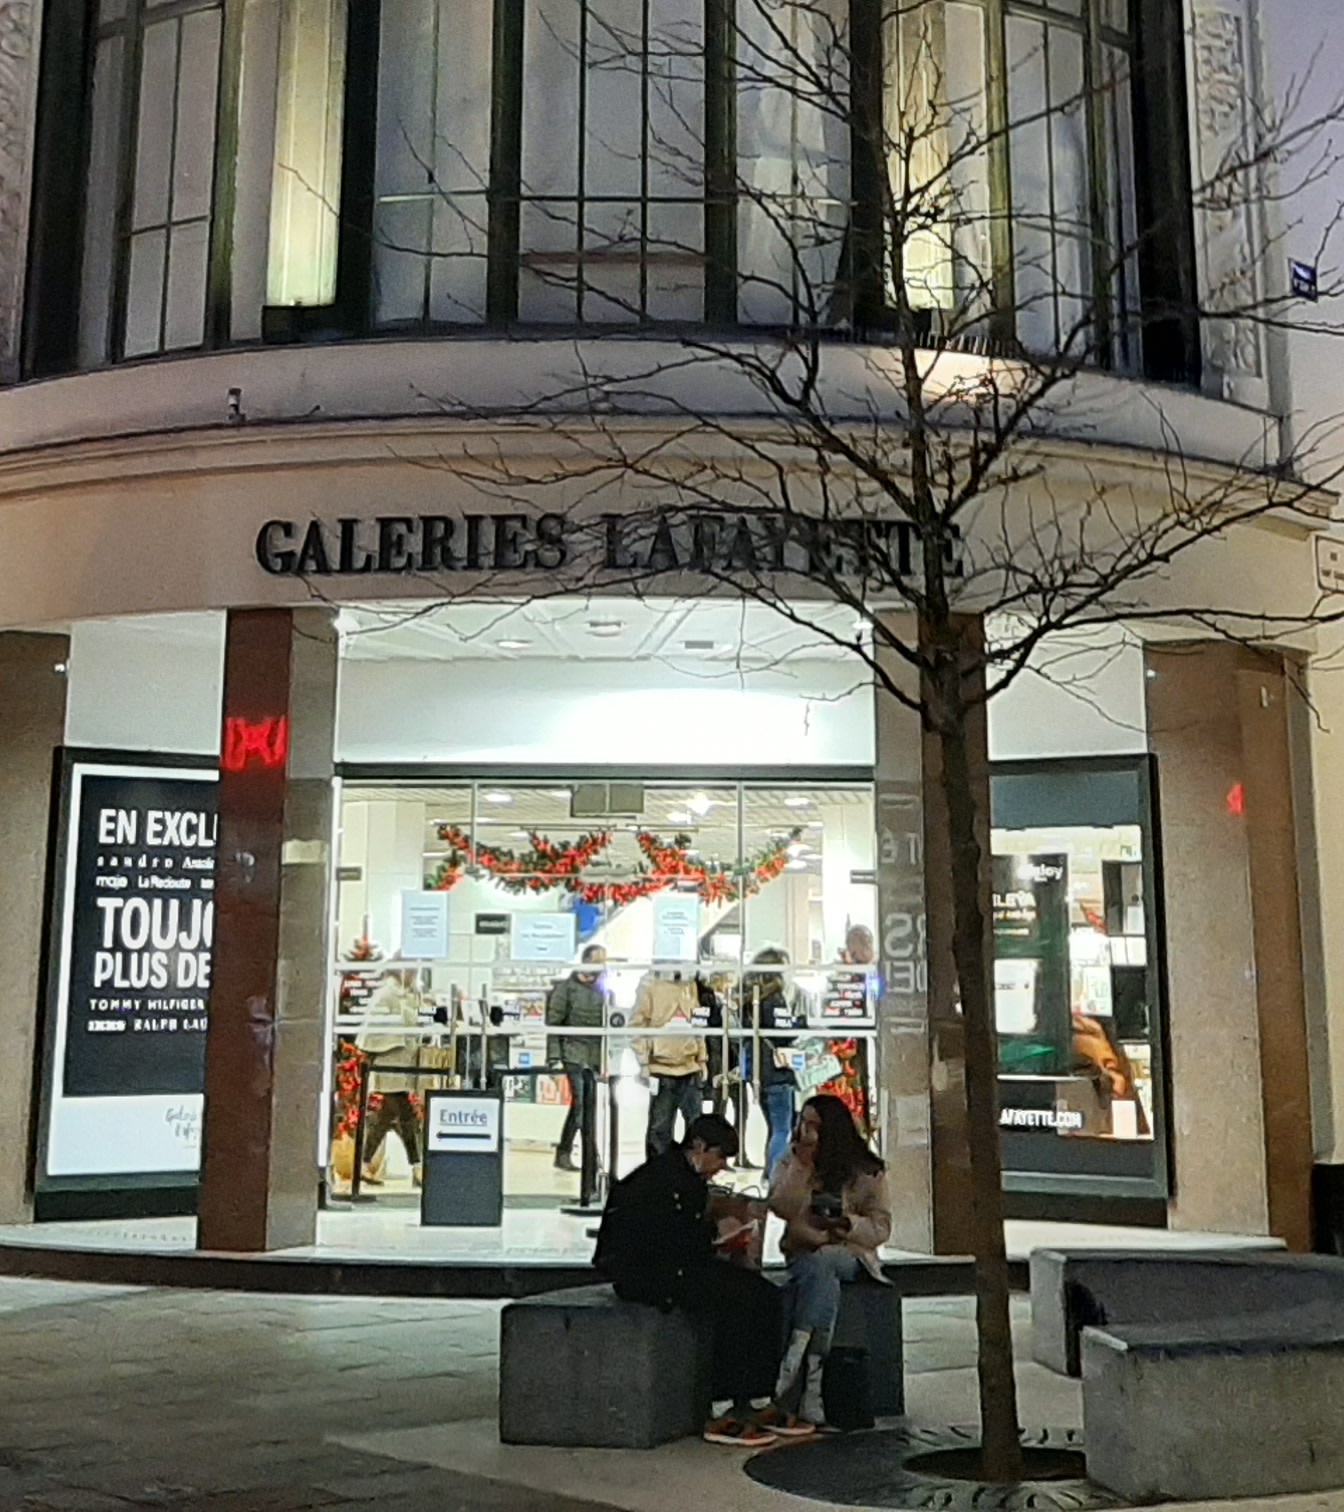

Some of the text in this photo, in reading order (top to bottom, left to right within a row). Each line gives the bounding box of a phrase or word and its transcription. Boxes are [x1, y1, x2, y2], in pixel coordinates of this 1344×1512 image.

[256, 515, 567, 575] GALERIES
[98, 808, 138, 845] EN
[94, 951, 212, 988] PLUS DE
[89, 998, 142, 1012] TOMMY
[133, 1018, 178, 1032] RALPH
[439, 1109, 488, 1124] Entrée
